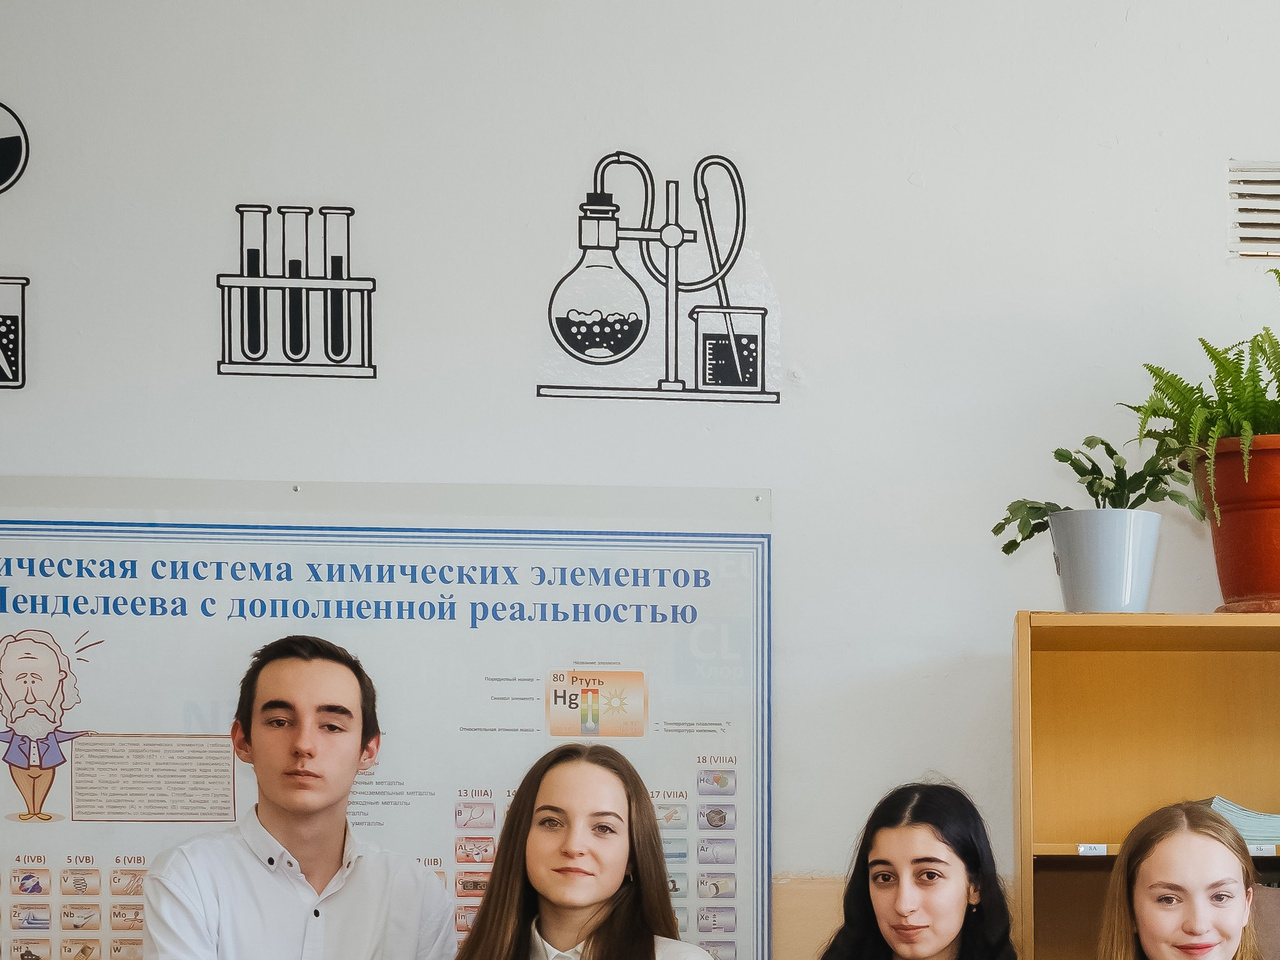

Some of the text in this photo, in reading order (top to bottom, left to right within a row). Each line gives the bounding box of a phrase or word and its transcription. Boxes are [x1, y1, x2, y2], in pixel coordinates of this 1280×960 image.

[151, 559, 294, 582] система
[306, 561, 520, 586] химических
[530, 565, 712, 588] элементов
[200, 597, 216, 617] с
[227, 592, 456, 621] дополненной
[469, 601, 698, 629] реальностью
[552, 673, 565, 682] 80
[571, 676, 604, 688] Ртуть
[554, 689, 579, 710] Hg
[697, 755, 737, 765] 18 (VIIIA)
[471, 789, 492, 798] (IIIA)
[663, 791, 688, 800] (VIIA)
[15, 855, 46, 865] 4 (IVB)
[74, 855, 94, 865] (VB)
[123, 855, 146, 865] (VIB)
[424, 858, 442, 867] (IIB)
